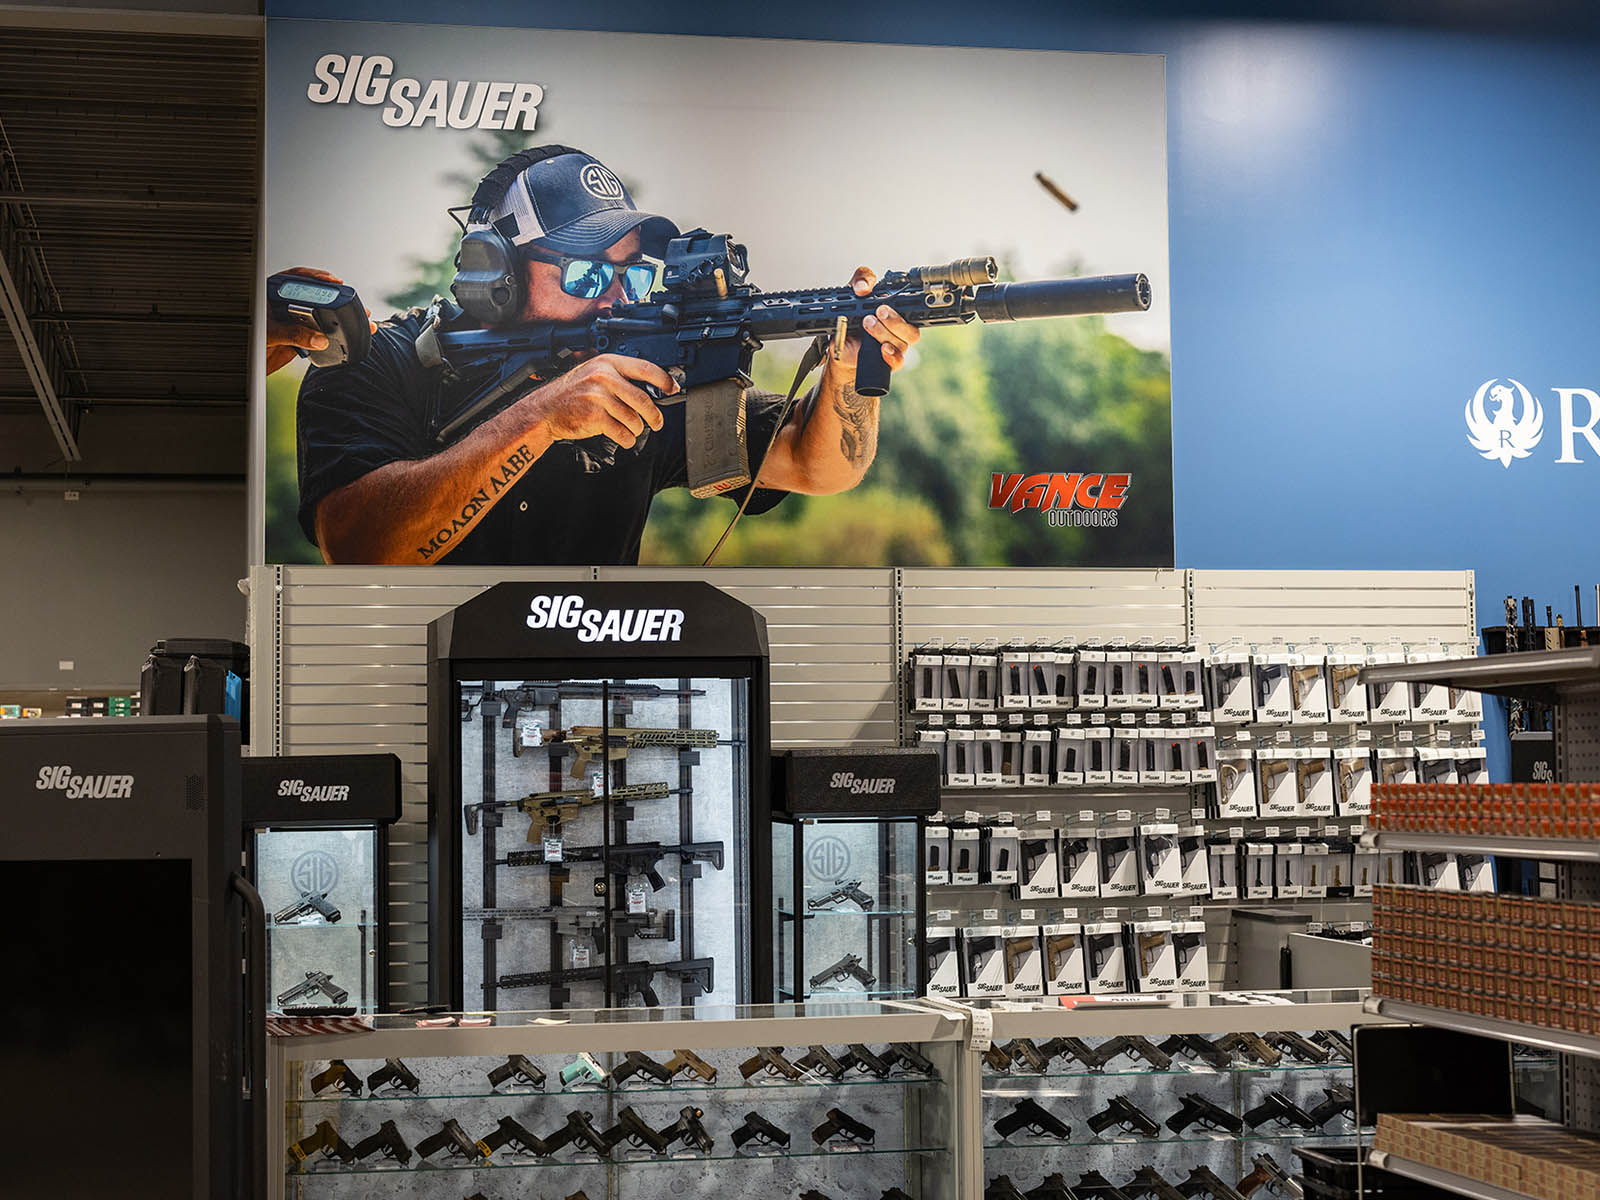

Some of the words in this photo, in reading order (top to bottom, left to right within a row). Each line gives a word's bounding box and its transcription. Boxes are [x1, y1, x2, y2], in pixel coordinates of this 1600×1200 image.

[307, 53, 395, 105] SIG
[382, 78, 544, 131] SAUER
[586, 167, 620, 196] SIG
[1499, 429, 1516, 449] R
[988, 472, 1132, 514] VANCE
[1047, 509, 1119, 528] OUTDOORS
[526, 595, 585, 629] SIG
[577, 609, 685, 643] SAUER
[36, 765, 72, 790] SIG
[65, 775, 134, 799] SAUER
[830, 772, 854, 788] SIG
[850, 778, 896, 794] SAUER
[1532, 761, 1548, 780] SIG
[277, 779, 305, 796] SIG
[300, 785, 350, 802] SAUER
[298, 857, 333, 891] SIG
[812, 842, 845, 875] SIG
